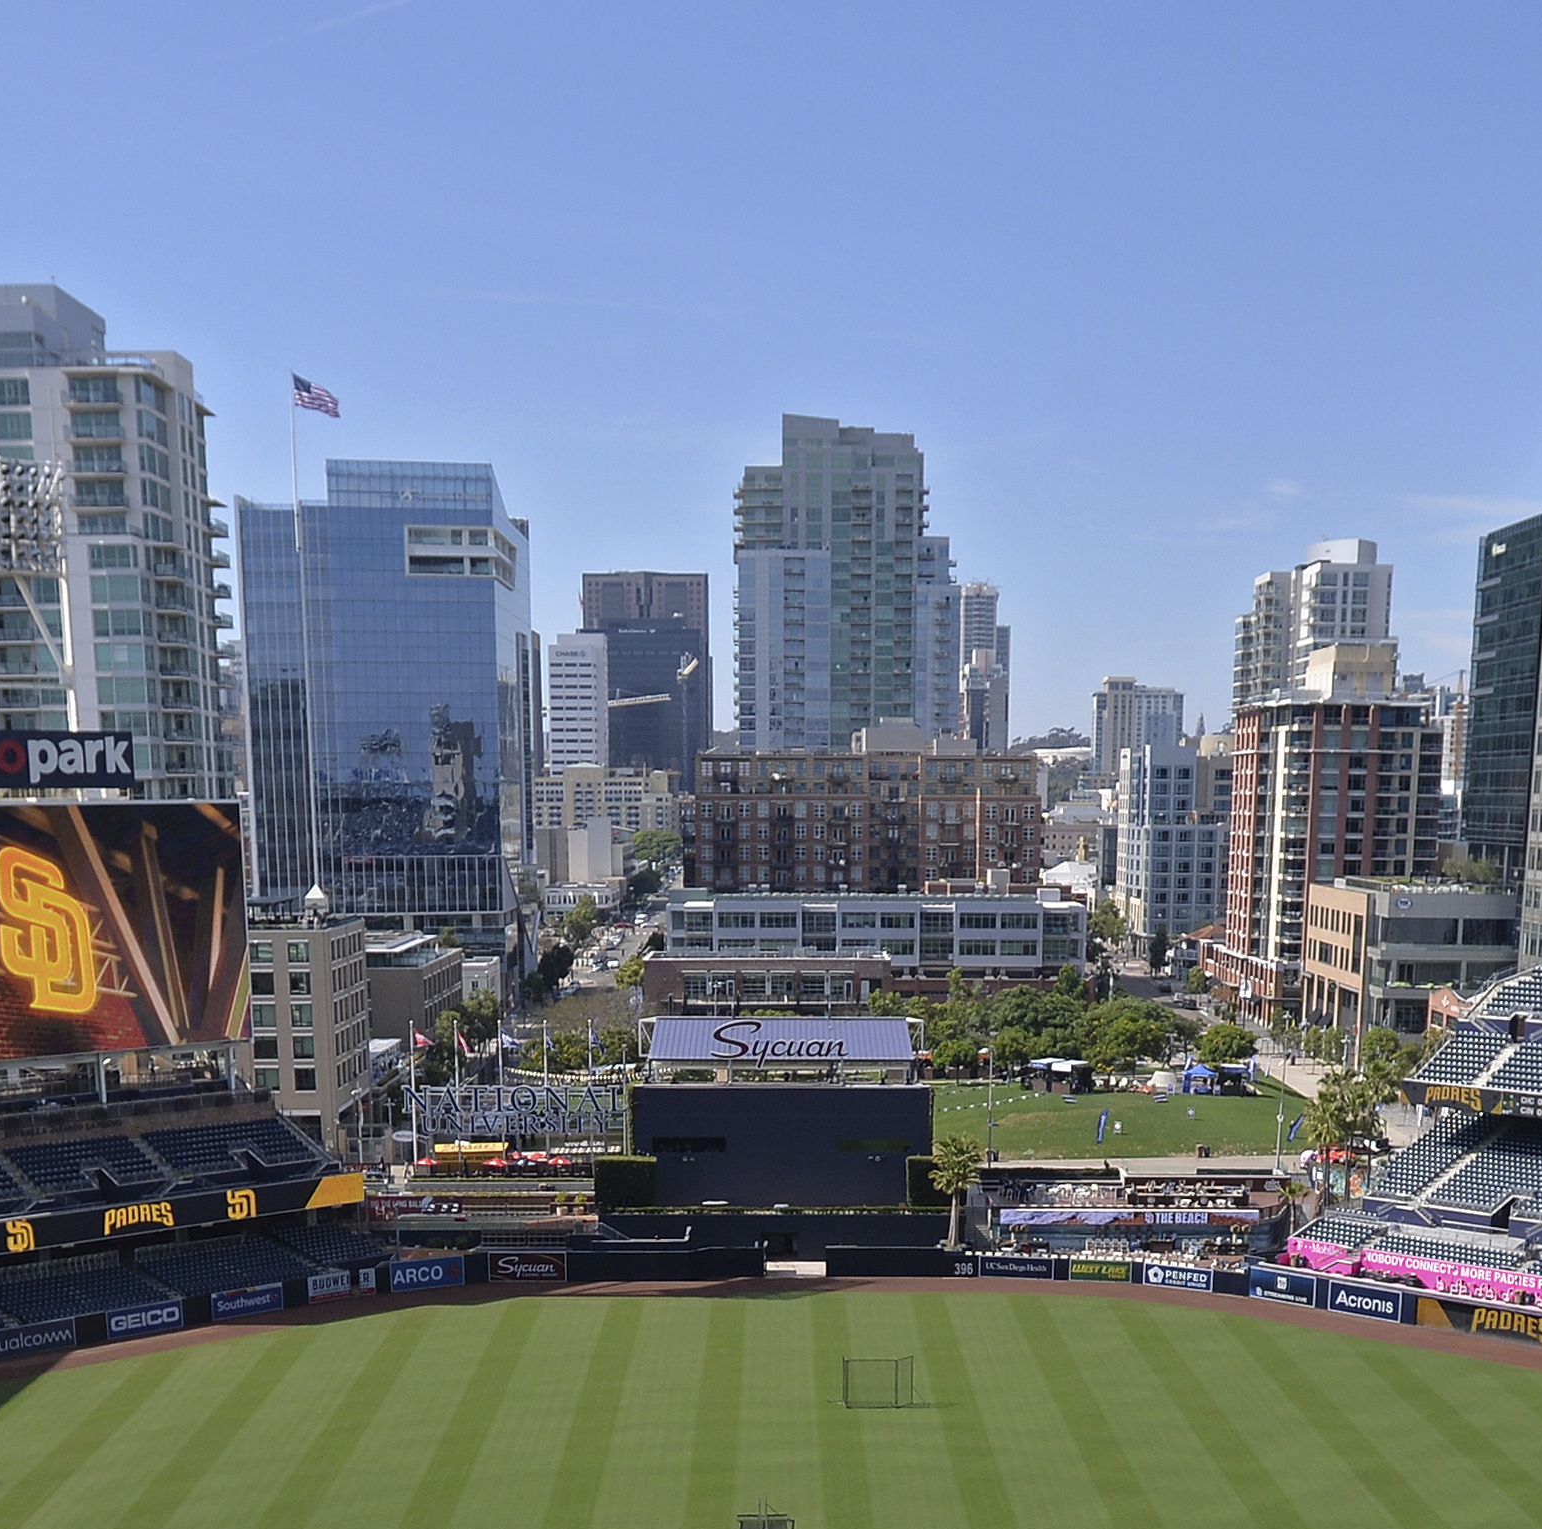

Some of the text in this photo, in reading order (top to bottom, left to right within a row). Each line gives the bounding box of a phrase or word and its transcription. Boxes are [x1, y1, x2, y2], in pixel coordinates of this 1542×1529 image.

[710, 1019, 849, 1069] Sycuan
[401, 1084, 628, 1114] NATIONAL
[1425, 1086, 1482, 1112] PADRES
[421, 1113, 610, 1134] UNIVERSITY
[104, 1201, 175, 1235] PADRES
[1154, 1212, 1208, 1224] THE BEACH
[393, 1265, 443, 1285] ARCO
[497, 1256, 556, 1278] Sycuan
[954, 1262, 974, 1275] 396
[1165, 1270, 1207, 1283] PENFED
[1364, 1251, 1404, 1267] NOBODY
[1460, 1267, 1492, 1281] MORE
[217, 1293, 271, 1312] Southwest
[1335, 1289, 1394, 1314] Acronis
[110, 1306, 180, 1332] GEICO
